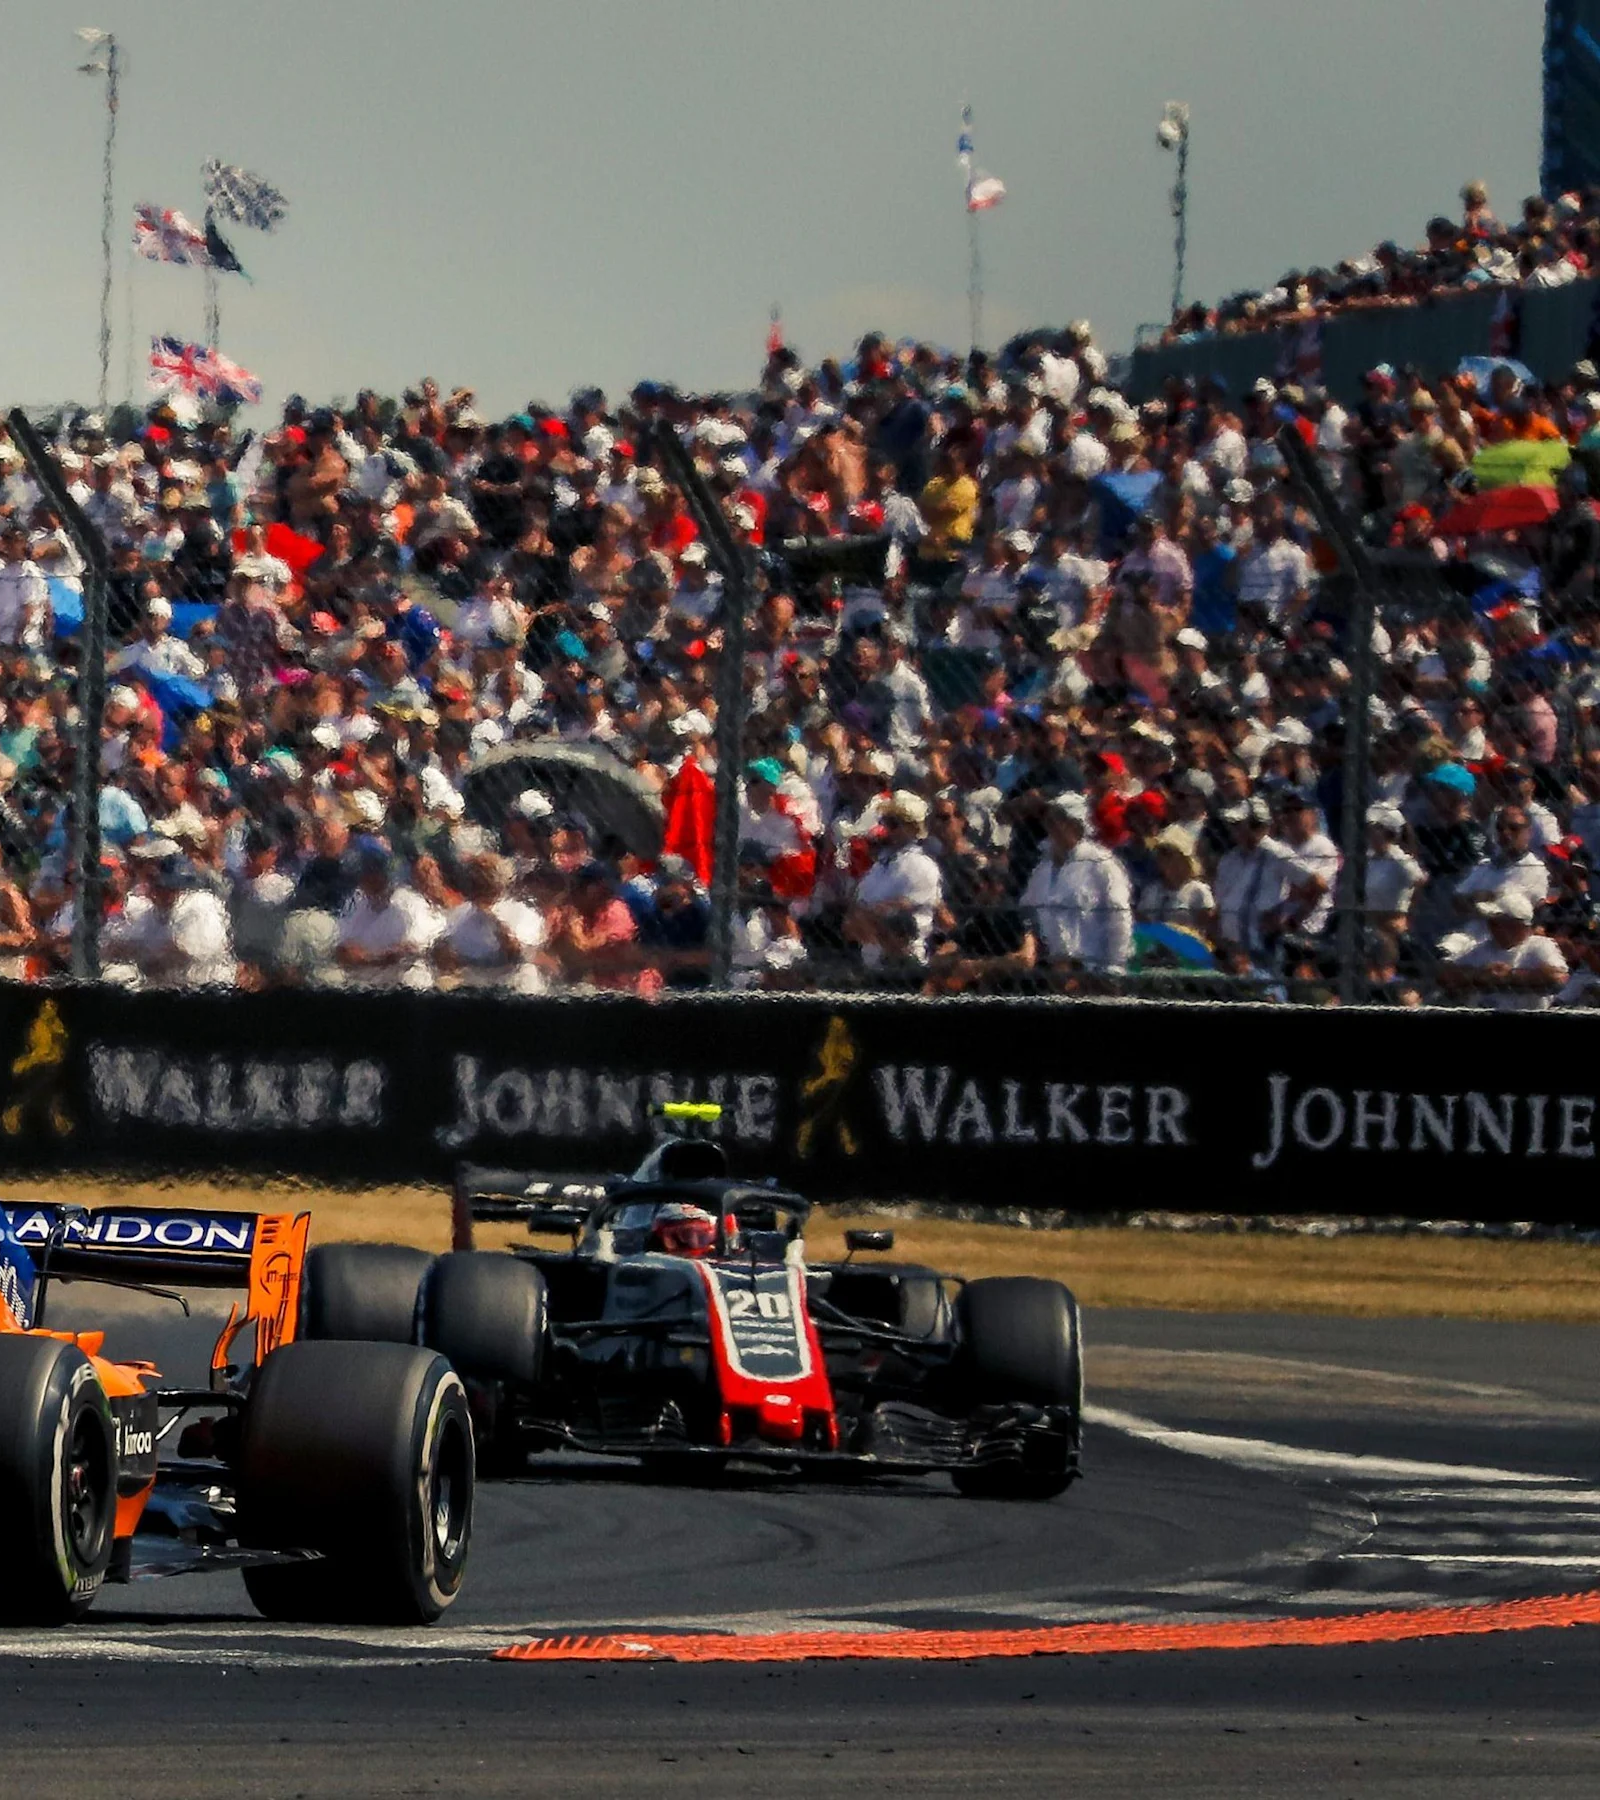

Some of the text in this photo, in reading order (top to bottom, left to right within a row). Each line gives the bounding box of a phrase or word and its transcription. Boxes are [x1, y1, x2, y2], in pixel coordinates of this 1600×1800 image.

[87, 1041, 388, 1129] WALKER
[435, 1053, 1189, 1148] JOHNNIE WALKER
[1252, 1072, 1597, 1169] JOHNNIE
[5, 1210, 250, 1249] ANDON
[726, 1289, 790, 1318] 20
